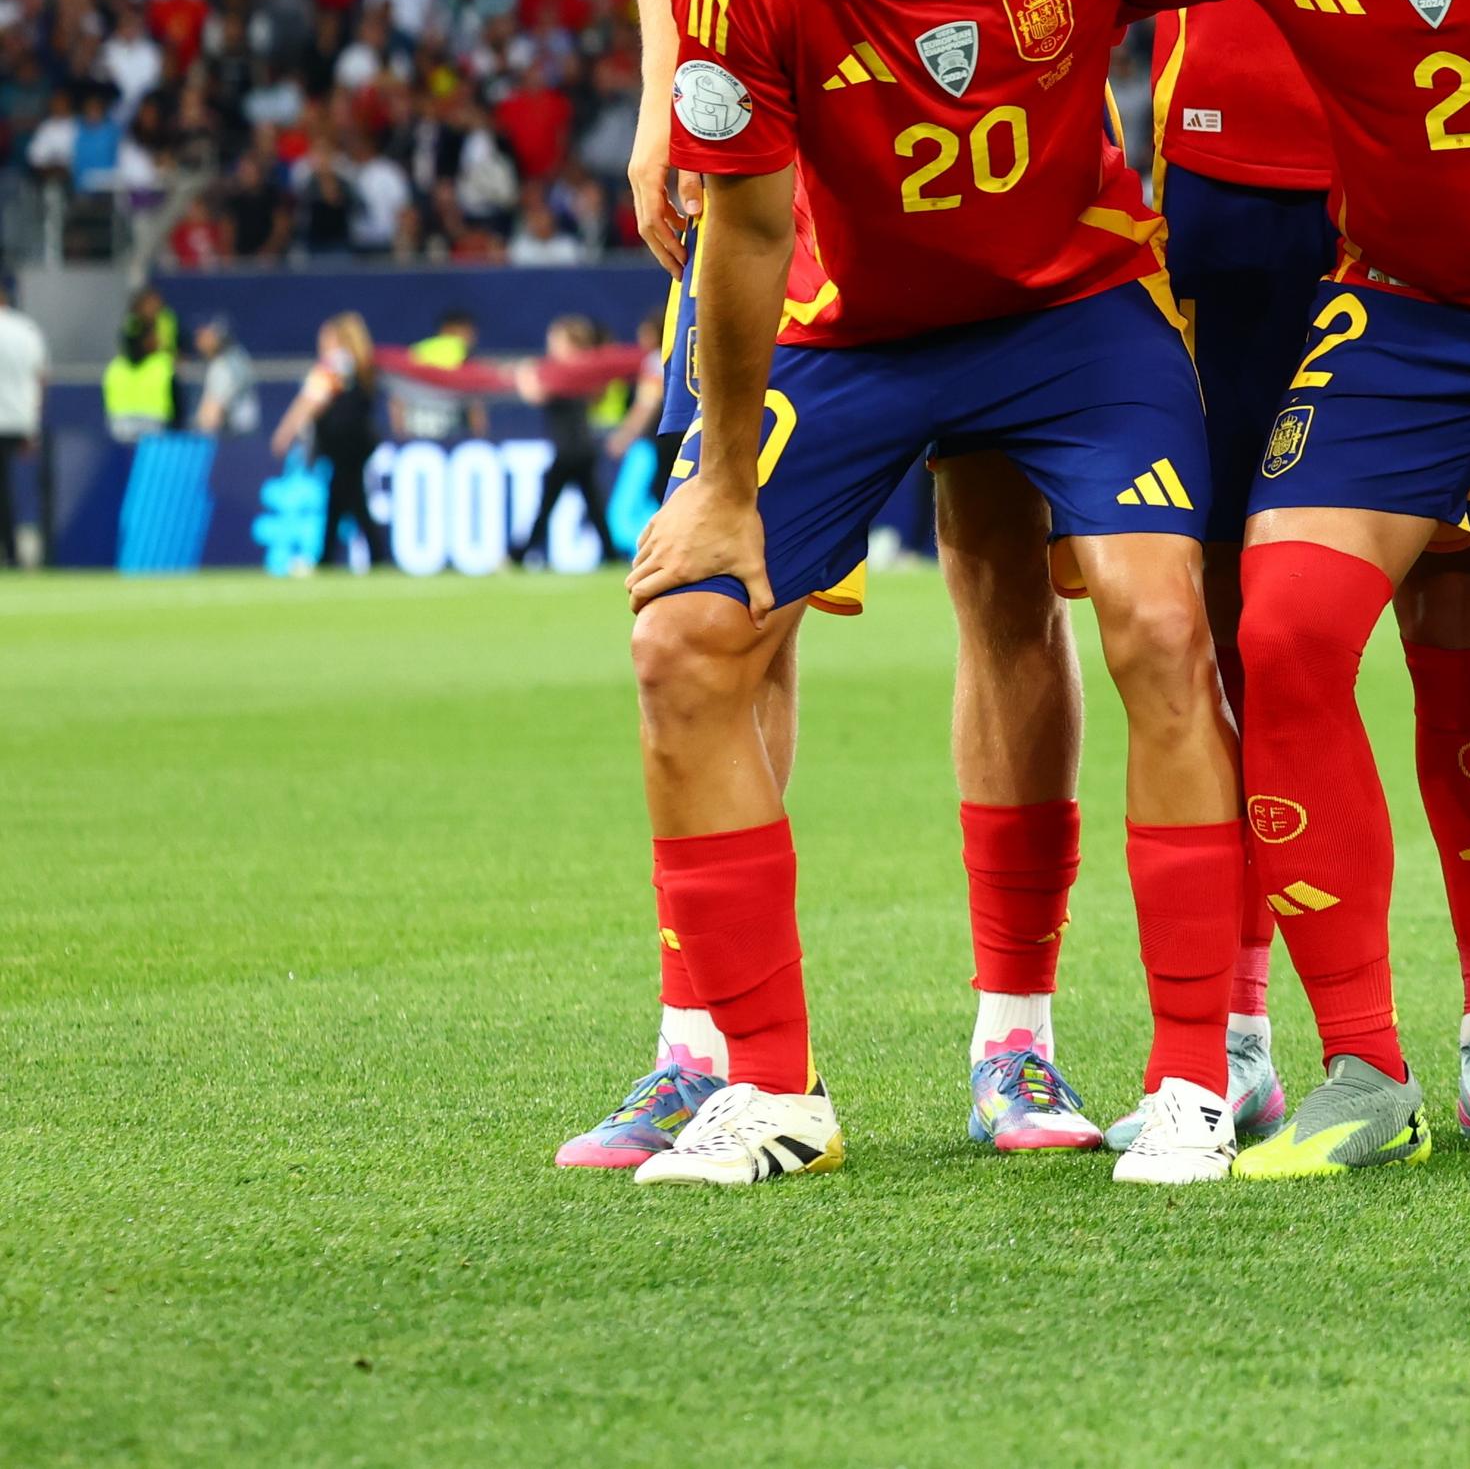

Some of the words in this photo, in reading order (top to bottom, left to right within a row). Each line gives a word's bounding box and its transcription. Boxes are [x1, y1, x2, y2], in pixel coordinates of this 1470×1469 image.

[895, 105, 1030, 213] 20
[1289, 292, 1368, 390] 2
[1254, 804, 1286, 819] RF
[1256, 818, 1288, 833] EF
